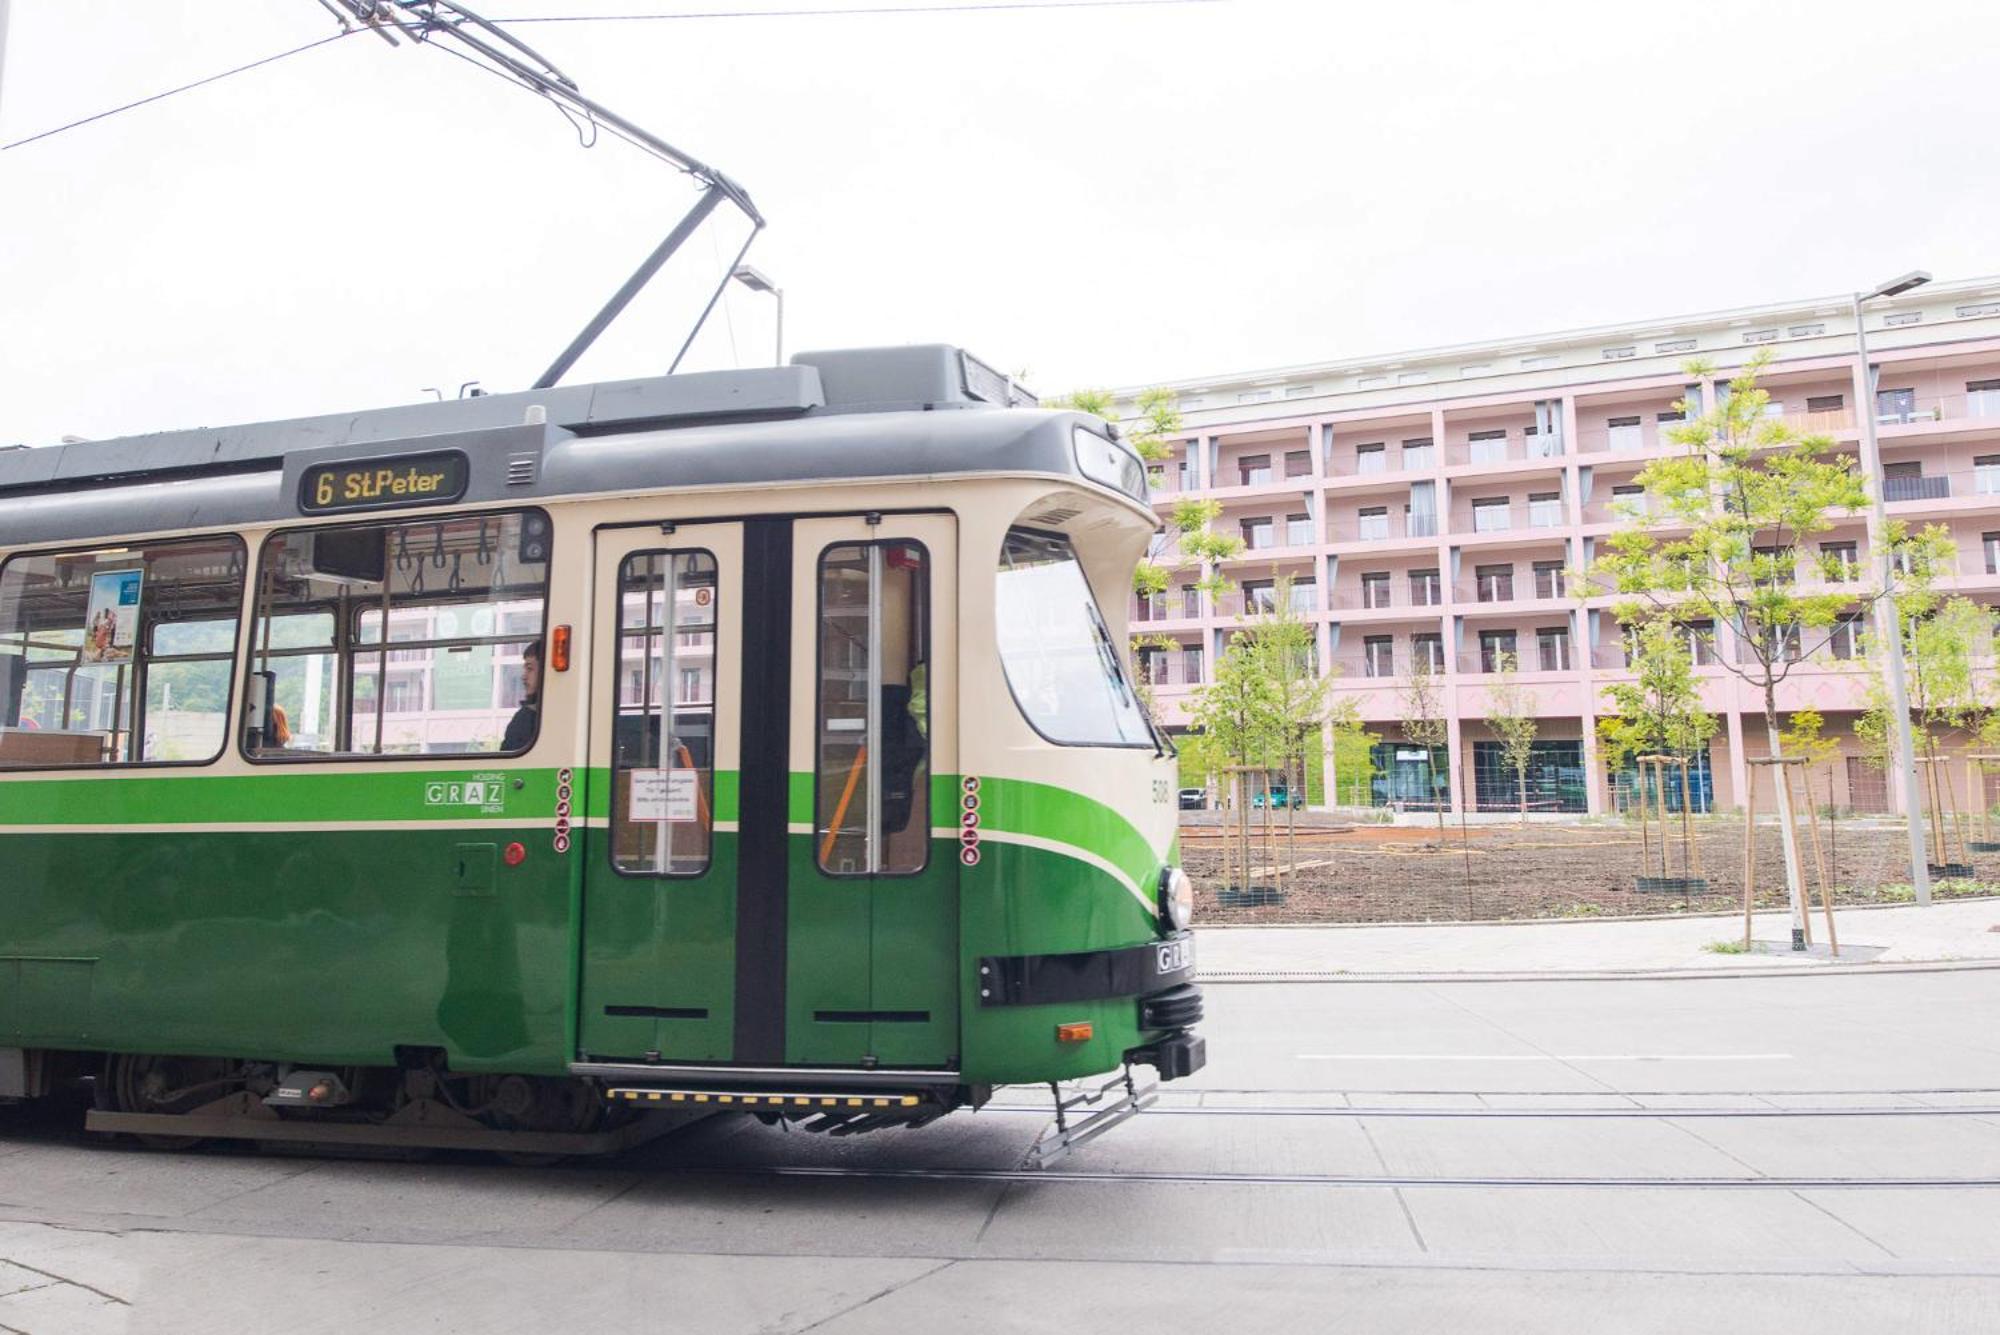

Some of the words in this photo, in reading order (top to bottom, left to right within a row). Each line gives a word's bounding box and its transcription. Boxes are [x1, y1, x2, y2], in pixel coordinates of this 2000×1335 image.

[316, 472, 335, 505] 6
[344, 467, 445, 499] St.Peter
[426, 783, 504, 804] GRAZ
